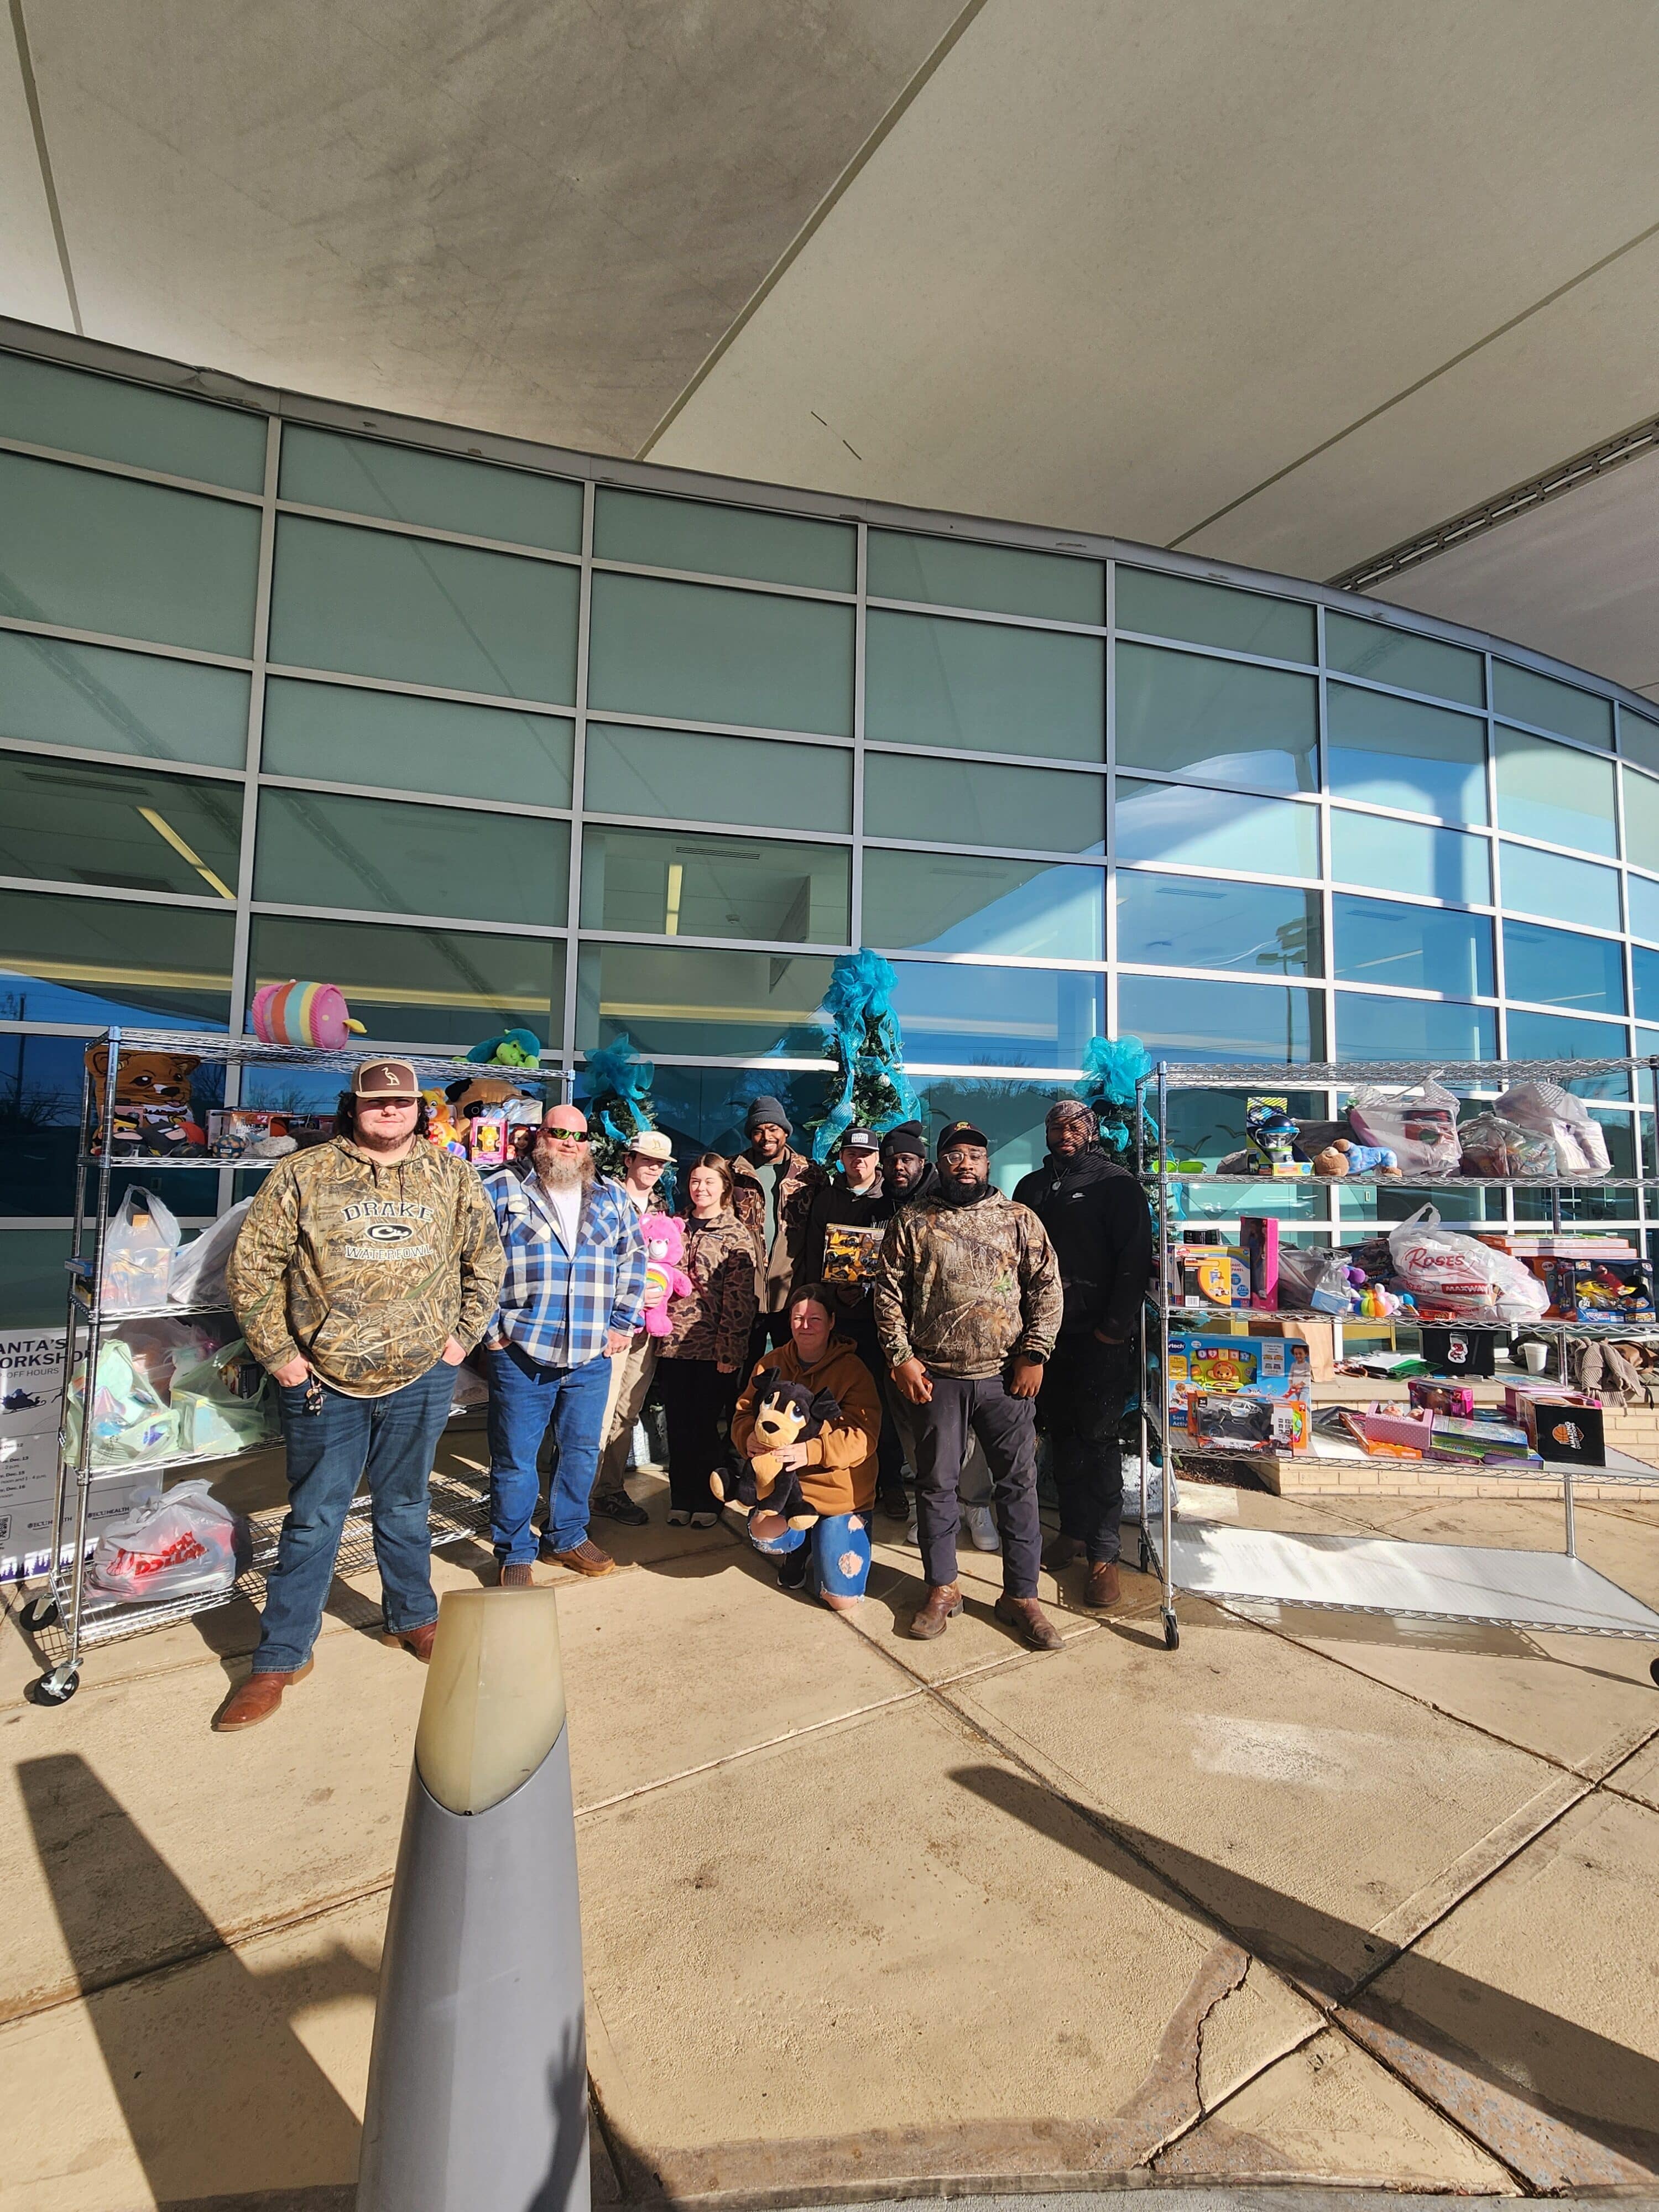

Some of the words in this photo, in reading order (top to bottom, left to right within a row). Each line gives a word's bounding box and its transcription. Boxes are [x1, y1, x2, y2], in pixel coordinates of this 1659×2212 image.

[341, 1201, 434, 1223] DRAKE
[345, 1244, 433, 1260] WATERFOWL
[1405, 1246, 1465, 1272] ROSES
[27, 1368, 59, 1376] HOURS
[107, 1506, 129, 1515] HEALTH
